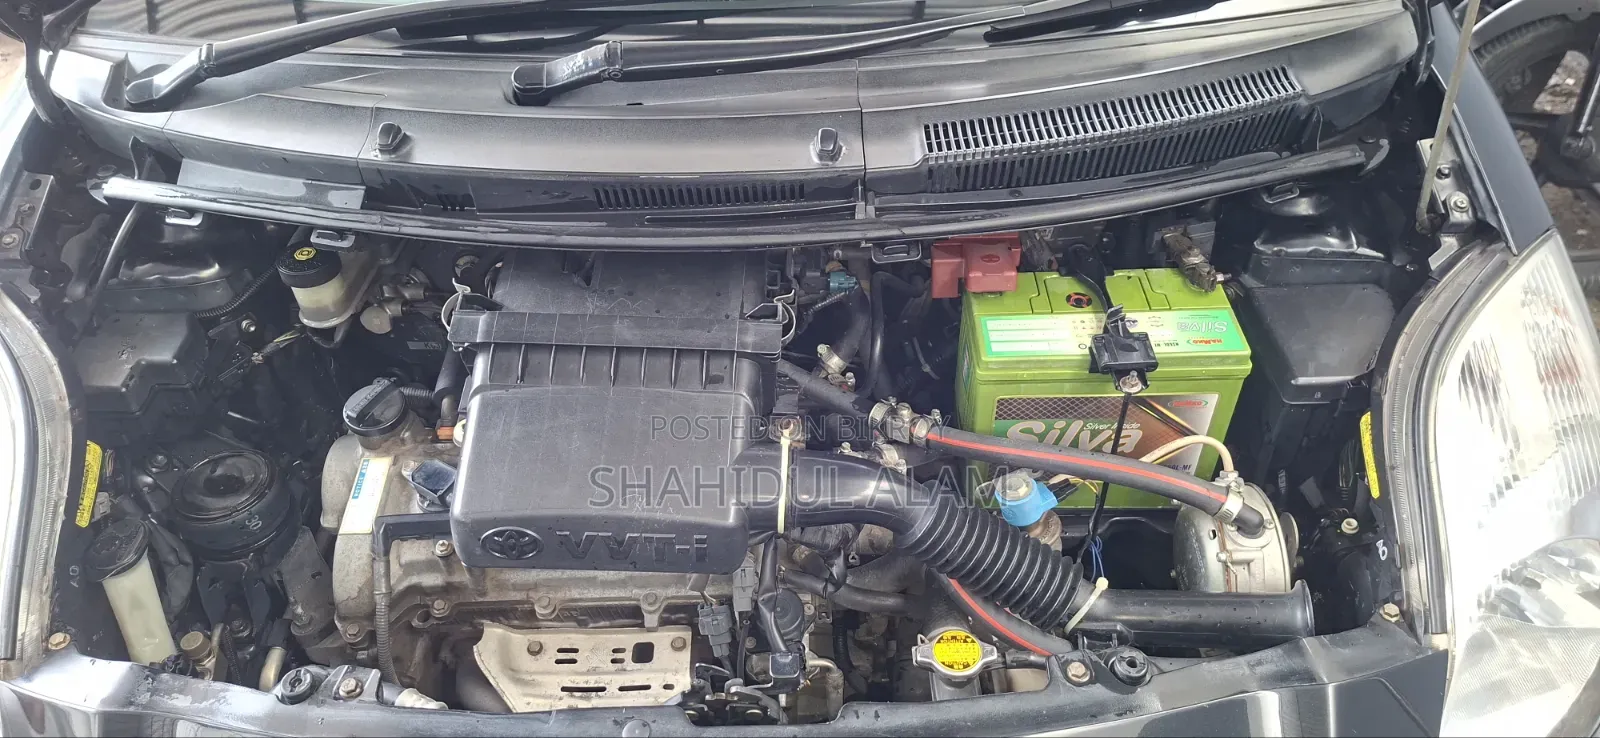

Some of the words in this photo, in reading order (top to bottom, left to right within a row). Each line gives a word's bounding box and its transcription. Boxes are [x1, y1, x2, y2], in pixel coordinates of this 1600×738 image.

[1083, 422, 1112, 430] Silver
[1111, 421, 1141, 430] Iside
[556, 531, 708, 563] VVT-i
